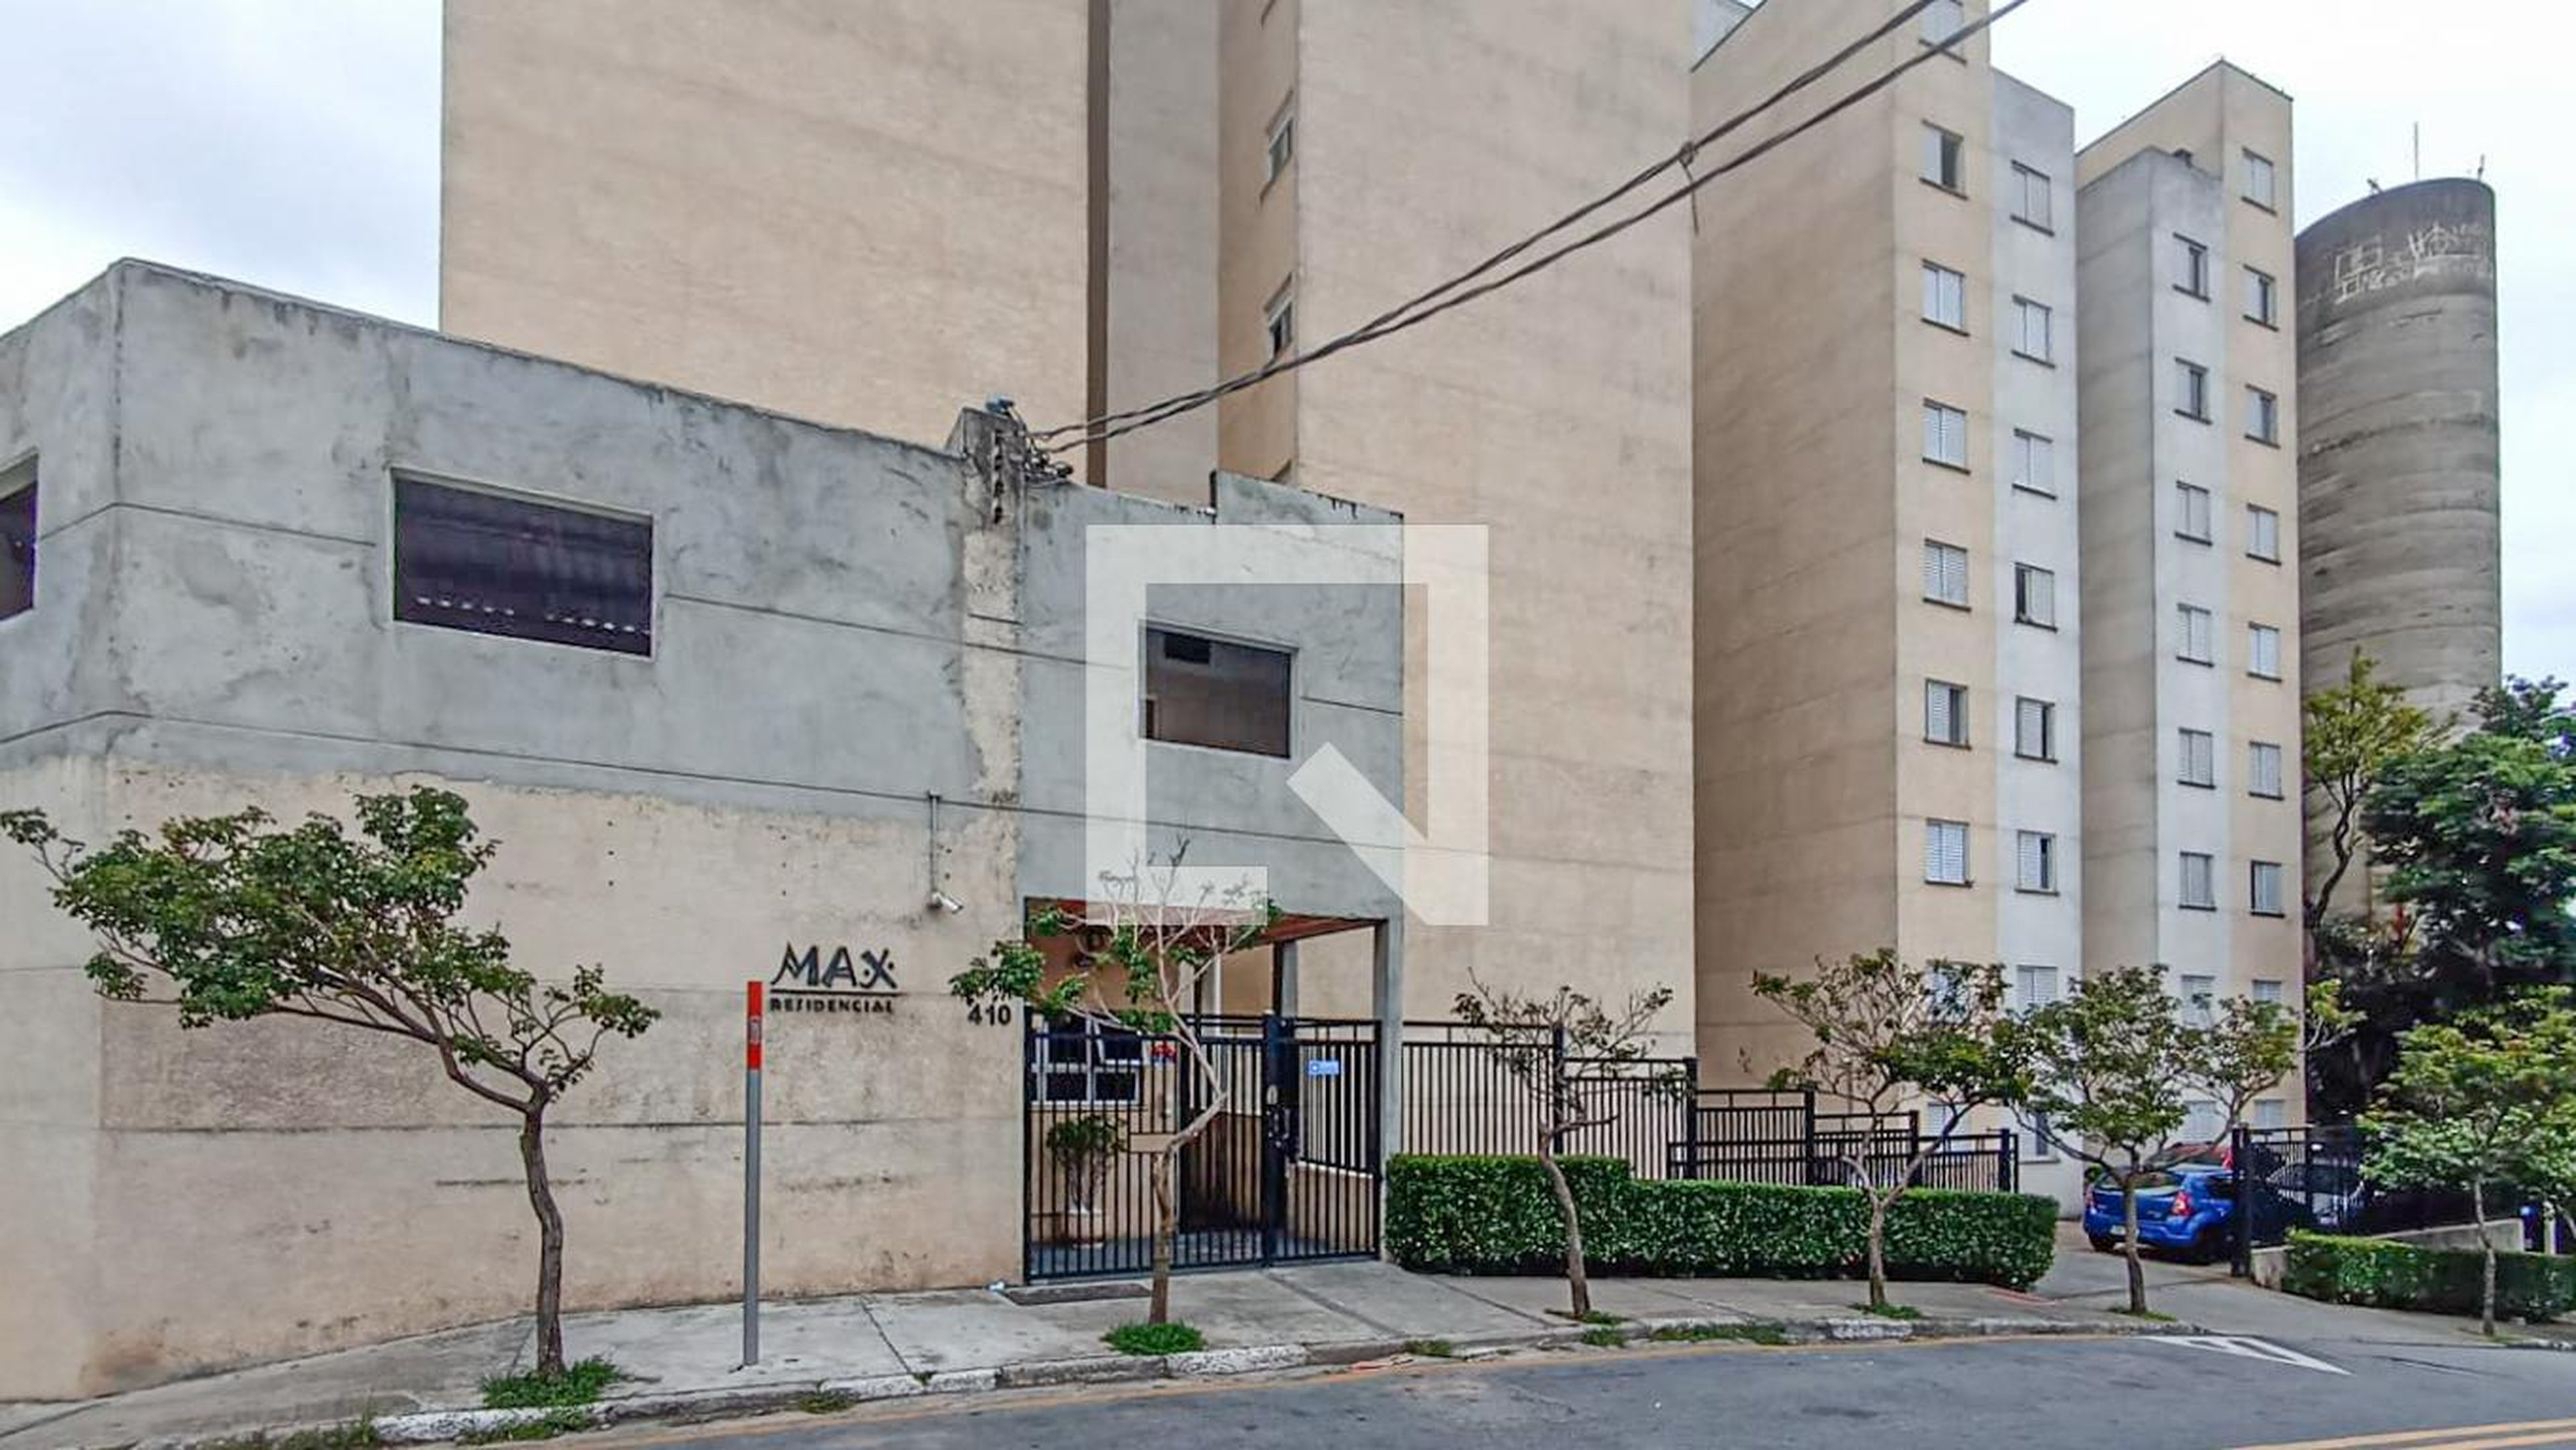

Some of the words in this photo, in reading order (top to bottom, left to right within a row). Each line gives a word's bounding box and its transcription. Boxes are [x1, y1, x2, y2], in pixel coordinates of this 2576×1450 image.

[771, 941, 898, 989] MAX
[769, 998, 894, 1013] RESIDENCIAL
[967, 1004, 1012, 1026] 410
